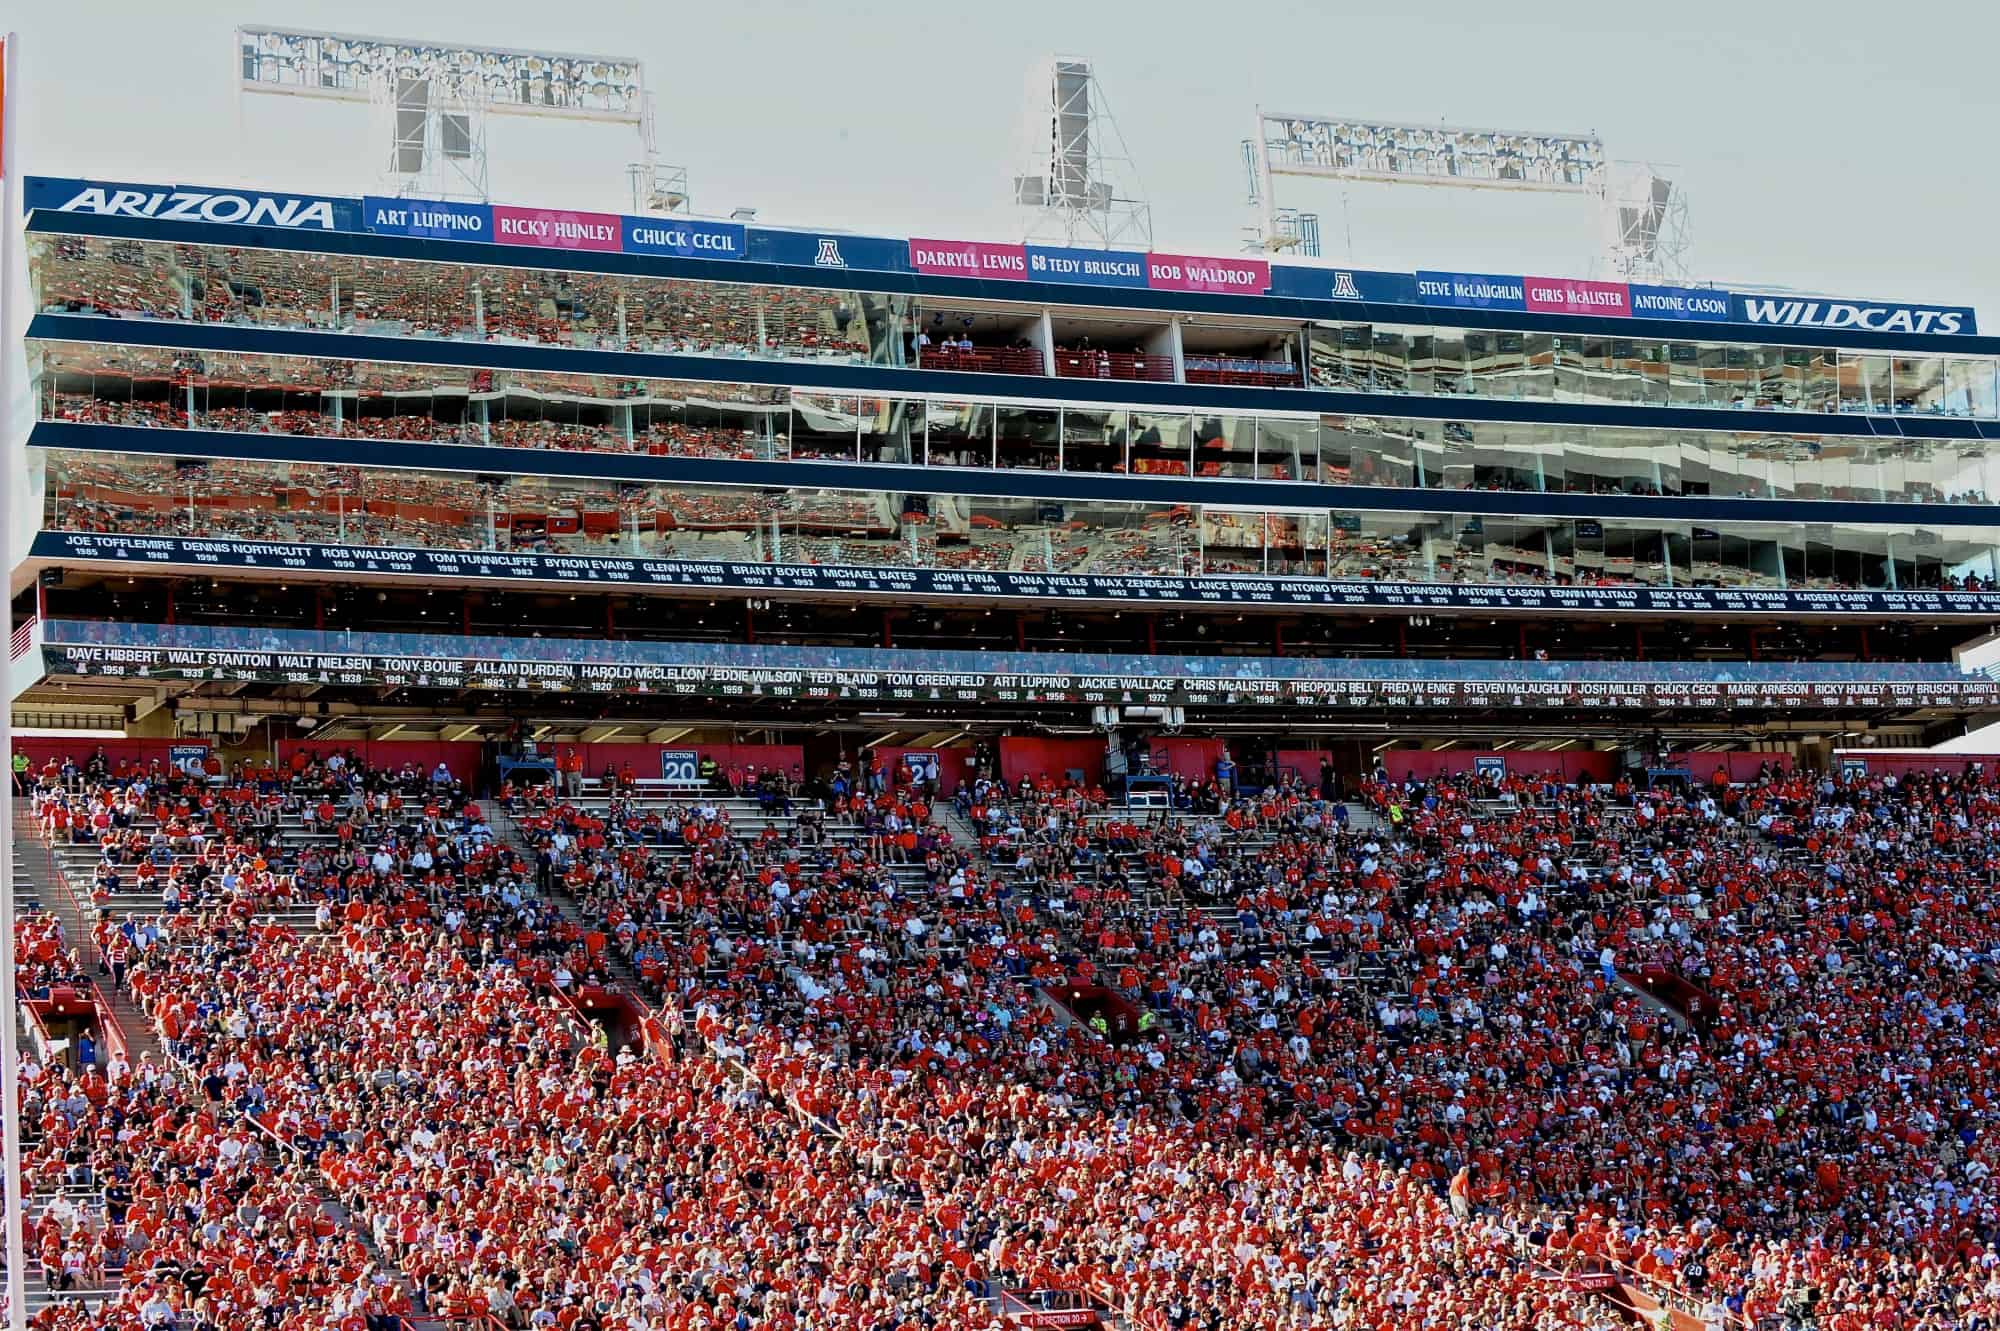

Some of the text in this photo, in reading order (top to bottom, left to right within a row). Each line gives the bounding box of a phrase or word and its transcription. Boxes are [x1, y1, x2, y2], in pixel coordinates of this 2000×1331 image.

[57, 187, 336, 229] ARIZONA
[376, 209, 482, 232] ART LUPPINO
[501, 218, 615, 241] RICKY HUNLEY
[632, 228, 735, 251] CHUCK CECIL
[916, 250, 1025, 271] DARRYLL LEWIS
[1031, 254, 1140, 277] 68 TEDY BRUSCHI
[1151, 264, 1256, 285] ROB WALDROP
[1418, 281, 1523, 300] STEVE McLAUGHLIN
[1531, 288, 1623, 306] CHRIS McALISTER
[1635, 295, 1727, 314] ANTOINE CASON
[1744, 299, 1963, 333] WILDCATS
[66, 537, 176, 550] JOE TOFFLEMIRE
[182, 542, 312, 557] DENNIS NORTHCUTT
[322, 548, 416, 561] ROB WALDROP
[426, 553, 539, 566] TOM TUNNICLIFFE
[544, 558, 634, 570] BYRON EVANS
[643, 562, 724, 574] GLENN PARKER
[732, 566, 818, 578] BRANT BOYER
[822, 569, 917, 581] MICHAEL BATES
[932, 573, 996, 584] JOHN FINA
[1008, 576, 1088, 587] DANA WELLS
[1094, 578, 1184, 589] MAX ZENDEJAS
[1190, 581, 1274, 591] LANCE BRIGGS
[1280, 583, 1370, 594] ANTONIO PIERCE
[1374, 586, 1453, 596] MIKE DAWSON
[1506, 589, 1546, 598] CASON
[1677, 592, 1704, 600] FOLK
[66, 648, 160, 663] DAVE HIBBERT
[168, 652, 271, 667] WALT STANTON
[278, 656, 372, 670] WALT NIELSEN
[383, 659, 463, 673] TONY BOUIE
[472, 662, 573, 676] ALLAN DURDEN
[102, 665, 125, 675] 1958
[182, 668, 256, 680] 1939 1941
[582, 665, 706, 681] HAROLD McCLELLON
[286, 672, 362, 683] 1936 1938
[385, 675, 460, 687] 1991 1994
[713, 670, 802, 683] EDDIE WILSON
[810, 672, 878, 685] TED BLAND
[886, 674, 985, 686] TOM GREENFIELD
[993, 676, 1070, 689] ART LUPPINO
[483, 678, 504, 688] 1982
[591, 682, 696, 693] 1920 1922
[1078, 678, 1174, 690] JACKIE WALLACE
[1183, 679, 1280, 692] CHRIS McALISTER
[1290, 682, 1374, 693] THEOPOLIS BELL
[1382, 683, 1410, 693] FRED
[1427, 683, 1456, 694] ENKE
[1463, 683, 1572, 694] STEVEN McLAUGHLIN
[1814, 684, 1885, 694] RICKY HUNLEY
[722, 685, 793, 696] 1959 1961
[858, 688, 878, 698] 1935
[894, 689, 913, 698] 1936
[1577, 684, 1646, 695] JOSH MILLER
[1654, 684, 1720, 695] CHUCK CECIL
[1727, 684, 1809, 695] MARK ARNESON
[1890, 684, 1958, 695] TEDY BRUSCHI
[998, 691, 1065, 702] 1953 1956
[1084, 693, 1168, 703] 1970 1972
[1295, 696, 1314, 705] 1972
[665, 761, 696, 780] 20
[1689, 1265, 1702, 1276] 20
